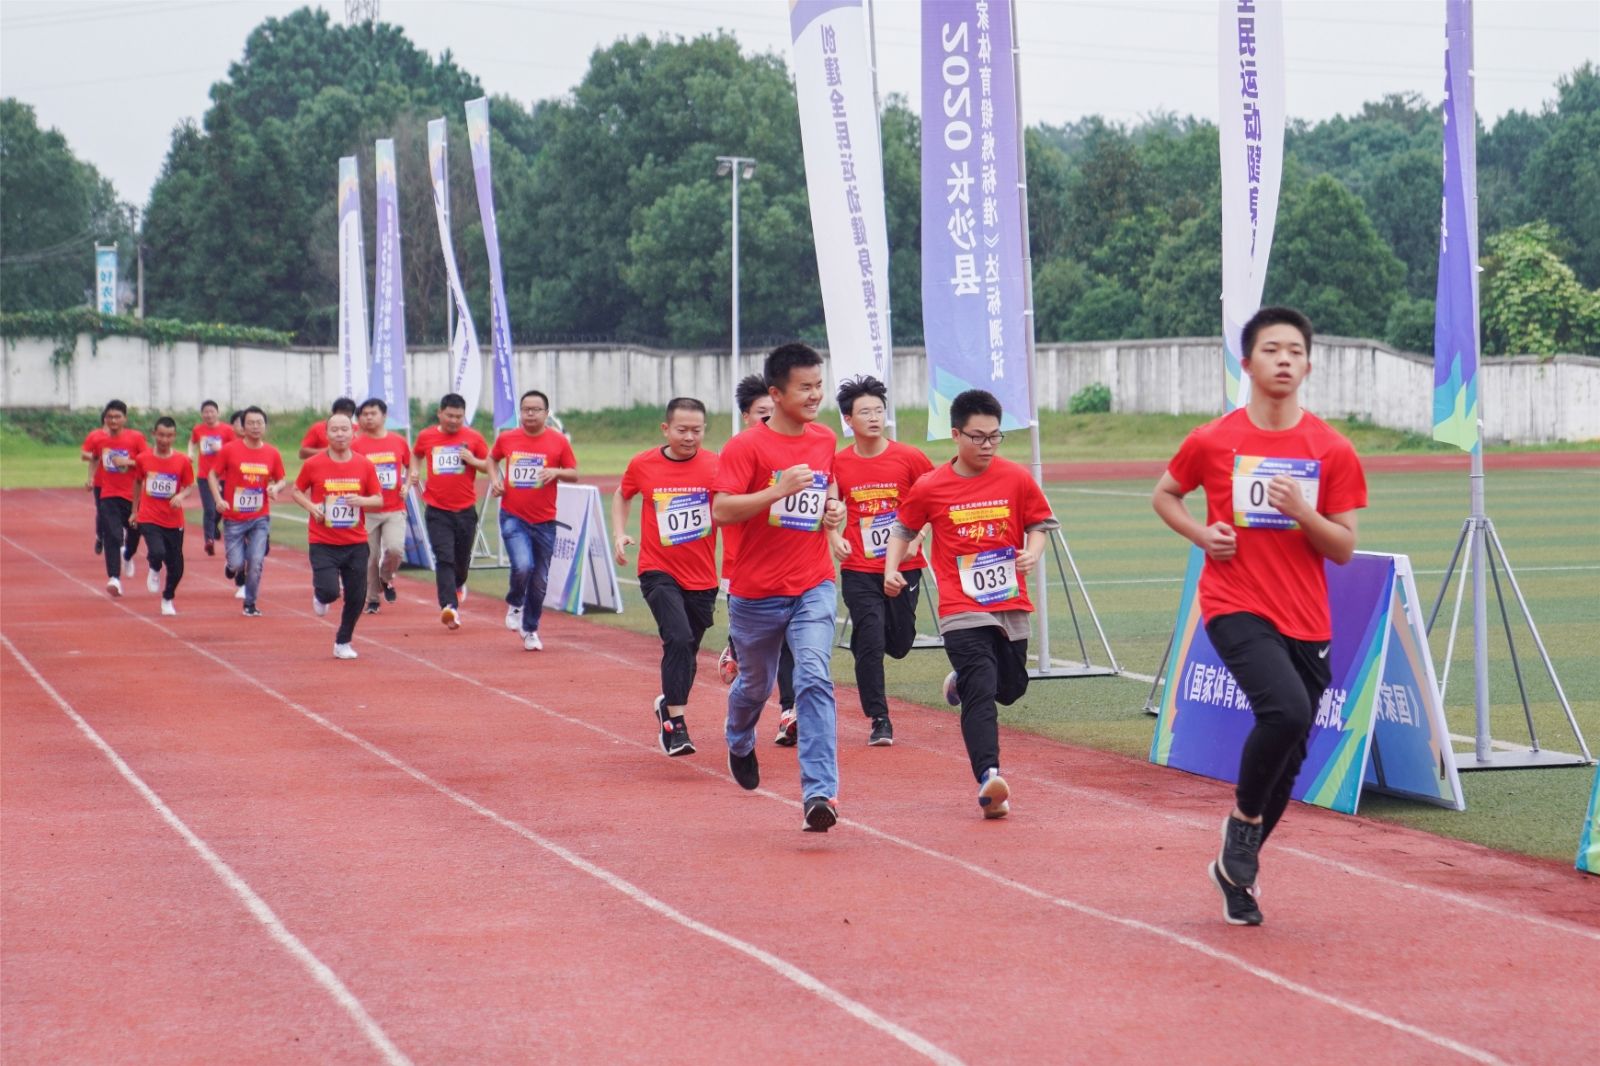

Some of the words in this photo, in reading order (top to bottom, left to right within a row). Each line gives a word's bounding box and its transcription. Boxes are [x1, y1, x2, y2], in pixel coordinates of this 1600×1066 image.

[438, 455, 459, 466] 049
[513, 468, 536, 480] 072
[151, 481, 171, 492] 066
[239, 496, 258, 506] 071
[785, 493, 819, 515] 063
[332, 506, 355, 519] 074
[667, 509, 702, 532] 075
[973, 566, 1007, 591] 033
[1184, 661, 1252, 713] 《国家体育
